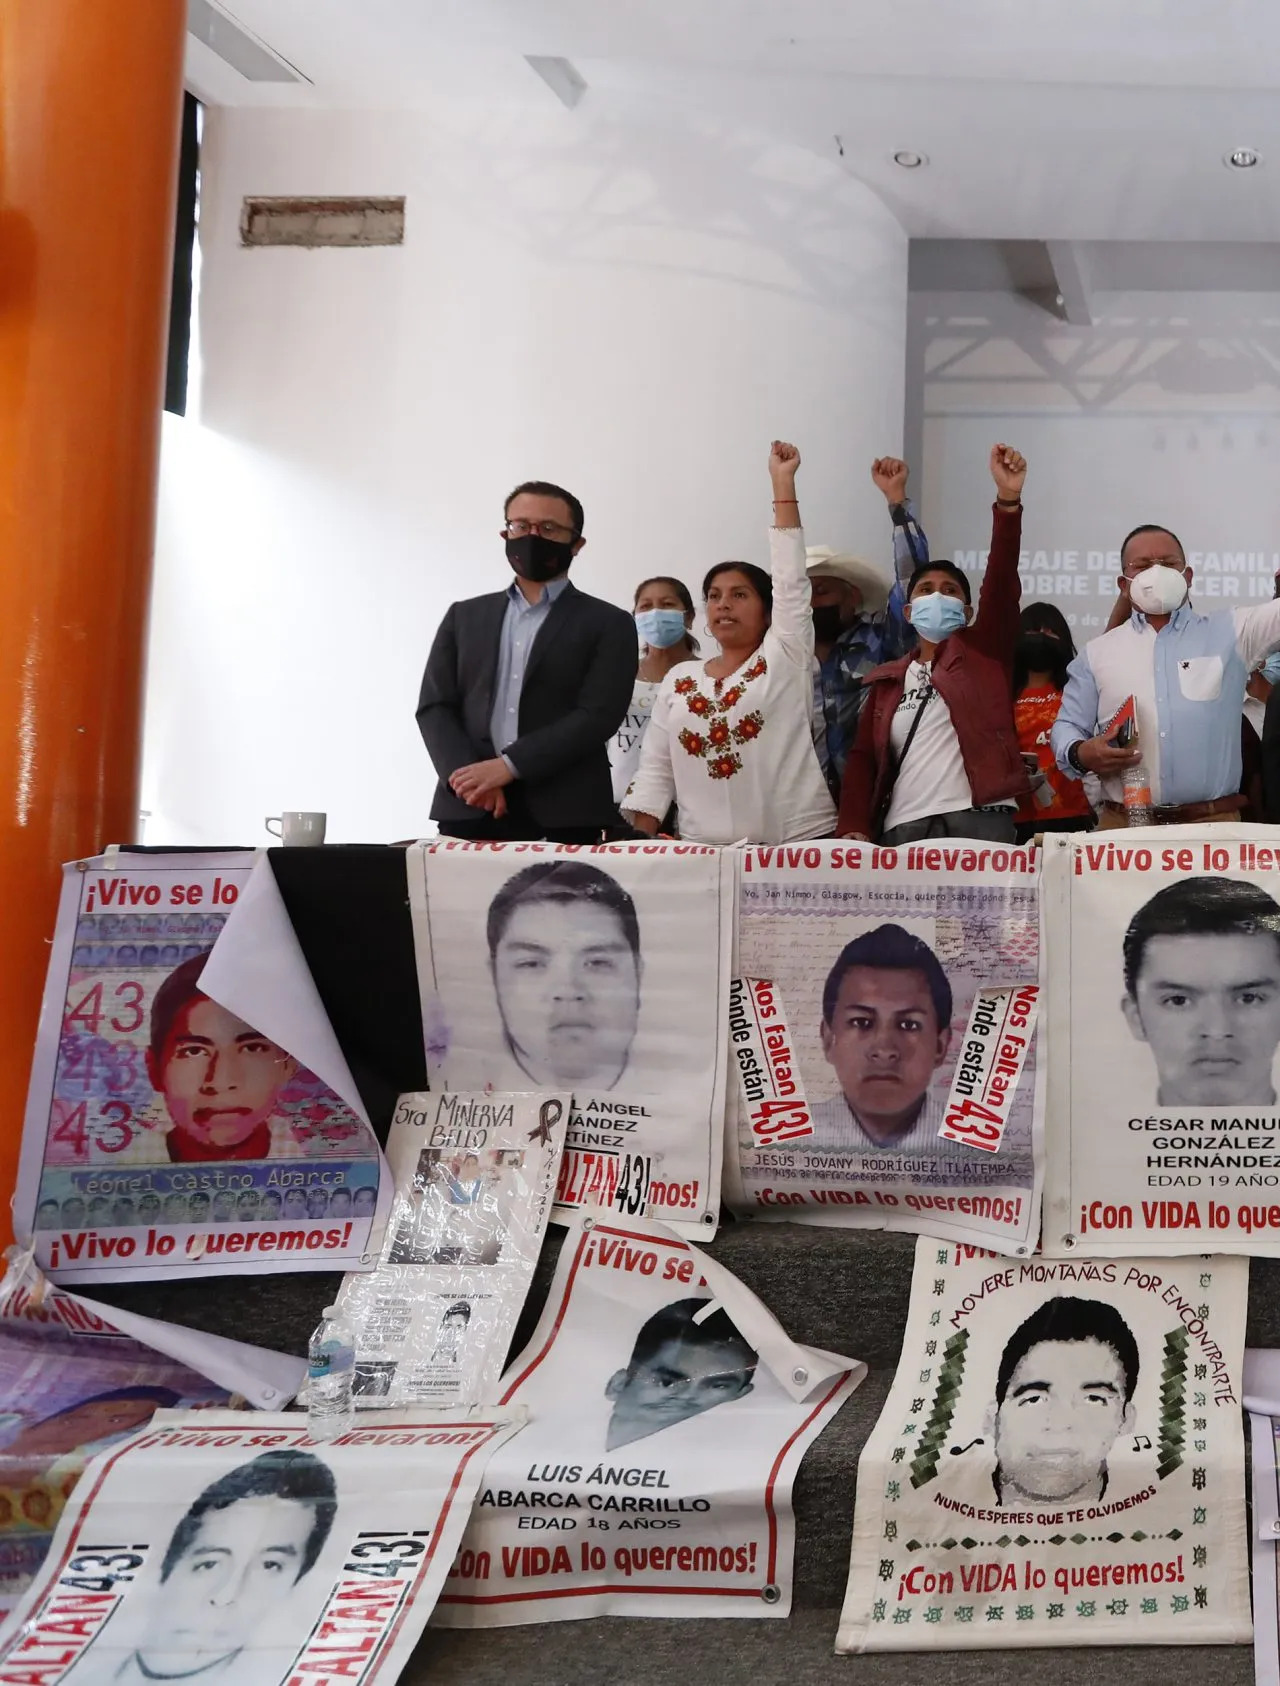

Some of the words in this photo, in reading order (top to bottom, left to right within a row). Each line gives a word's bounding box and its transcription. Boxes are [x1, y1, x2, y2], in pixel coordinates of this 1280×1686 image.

[744, 846, 822, 872] ¡Vivo
[830, 848, 862, 870] se
[871, 848, 898, 870] lo
[907, 846, 1036, 873] llevaron!
[1074, 843, 1152, 875] ¡Vivo
[1161, 848, 1194, 872] se
[1203, 844, 1231, 871] lo
[86, 878, 161, 912] ¡Vivo
[170, 884, 203, 905] se
[212, 878, 239, 904] lo
[765, 890, 782, 899] Jan
[821, 890, 863, 902] Glasgow,
[868, 891, 909, 902] Escocia,
[914, 892, 946, 902] quiero
[951, 893, 976, 902] saber
[736, 1048, 765, 1102] están
[764, 1023, 798, 1097] faltan
[954, 1042, 986, 1097] están
[985, 1034, 1027, 1108] faltan
[395, 1101, 428, 1127] Sra
[587, 1097, 653, 1118] ÁNGEL
[751, 1099, 815, 1145] 43!
[1128, 1115, 1204, 1131] CÉSAR
[1152, 1134, 1276, 1151] GONZÁLEZ
[73, 1172, 151, 1194] Leonel
[170, 1172, 253, 1190] Castro
[266, 1167, 346, 1186] Abarca
[754, 1153, 795, 1167] JESÚS
[804, 1157, 853, 1170] JOVANY
[862, 1157, 938, 1173] RODRÍGUEZ
[947, 1162, 1016, 1175] TLATEMPA
[615, 1154, 651, 1217] 43!
[1147, 1175, 1202, 1187] EDAD
[1208, 1175, 1230, 1187] 19
[875, 1190, 900, 1207] lo
[905, 1194, 1023, 1226] queremos!
[1080, 1201, 1133, 1234] ¡Con
[1141, 1201, 1201, 1230] VIDA
[1208, 1201, 1231, 1230] lo
[50, 1232, 136, 1267] ¡Vivo
[145, 1229, 176, 1256] lo
[584, 1238, 658, 1275] ¡Vivo
[663, 1256, 694, 1283] se
[950, 1268, 1016, 1329] MOVERE
[1019, 1261, 1117, 1284] MONTAÑAS
[1124, 1267, 1162, 1293] POR
[1161, 1284, 1238, 1408] ENCONTRARTE
[248, 1433, 287, 1448] se
[526, 1463, 583, 1484] LUIS
[586, 1462, 671, 1489] ÁNGEL
[479, 1489, 582, 1510] ABARCA
[588, 1494, 712, 1513] CARRILLO
[934, 1491, 976, 1520] NUNCA
[978, 1509, 1034, 1524] ESPERES
[1037, 1513, 1065, 1526] QUE
[1067, 1509, 1085, 1523] TE
[1086, 1484, 1157, 1520] OLVIDEMOS
[518, 1516, 577, 1530] EDAD
[587, 1517, 610, 1532] 18
[618, 1517, 682, 1531] AÑOS
[342, 1530, 430, 1579] 43!
[501, 1542, 574, 1578] VIDA
[581, 1542, 606, 1572] lo
[614, 1542, 758, 1577] queremos!
[898, 1565, 954, 1601] ¡Con
[960, 1562, 1018, 1594] VIDA
[1025, 1560, 1047, 1590] lo
[1054, 1554, 1186, 1595] queremos!
